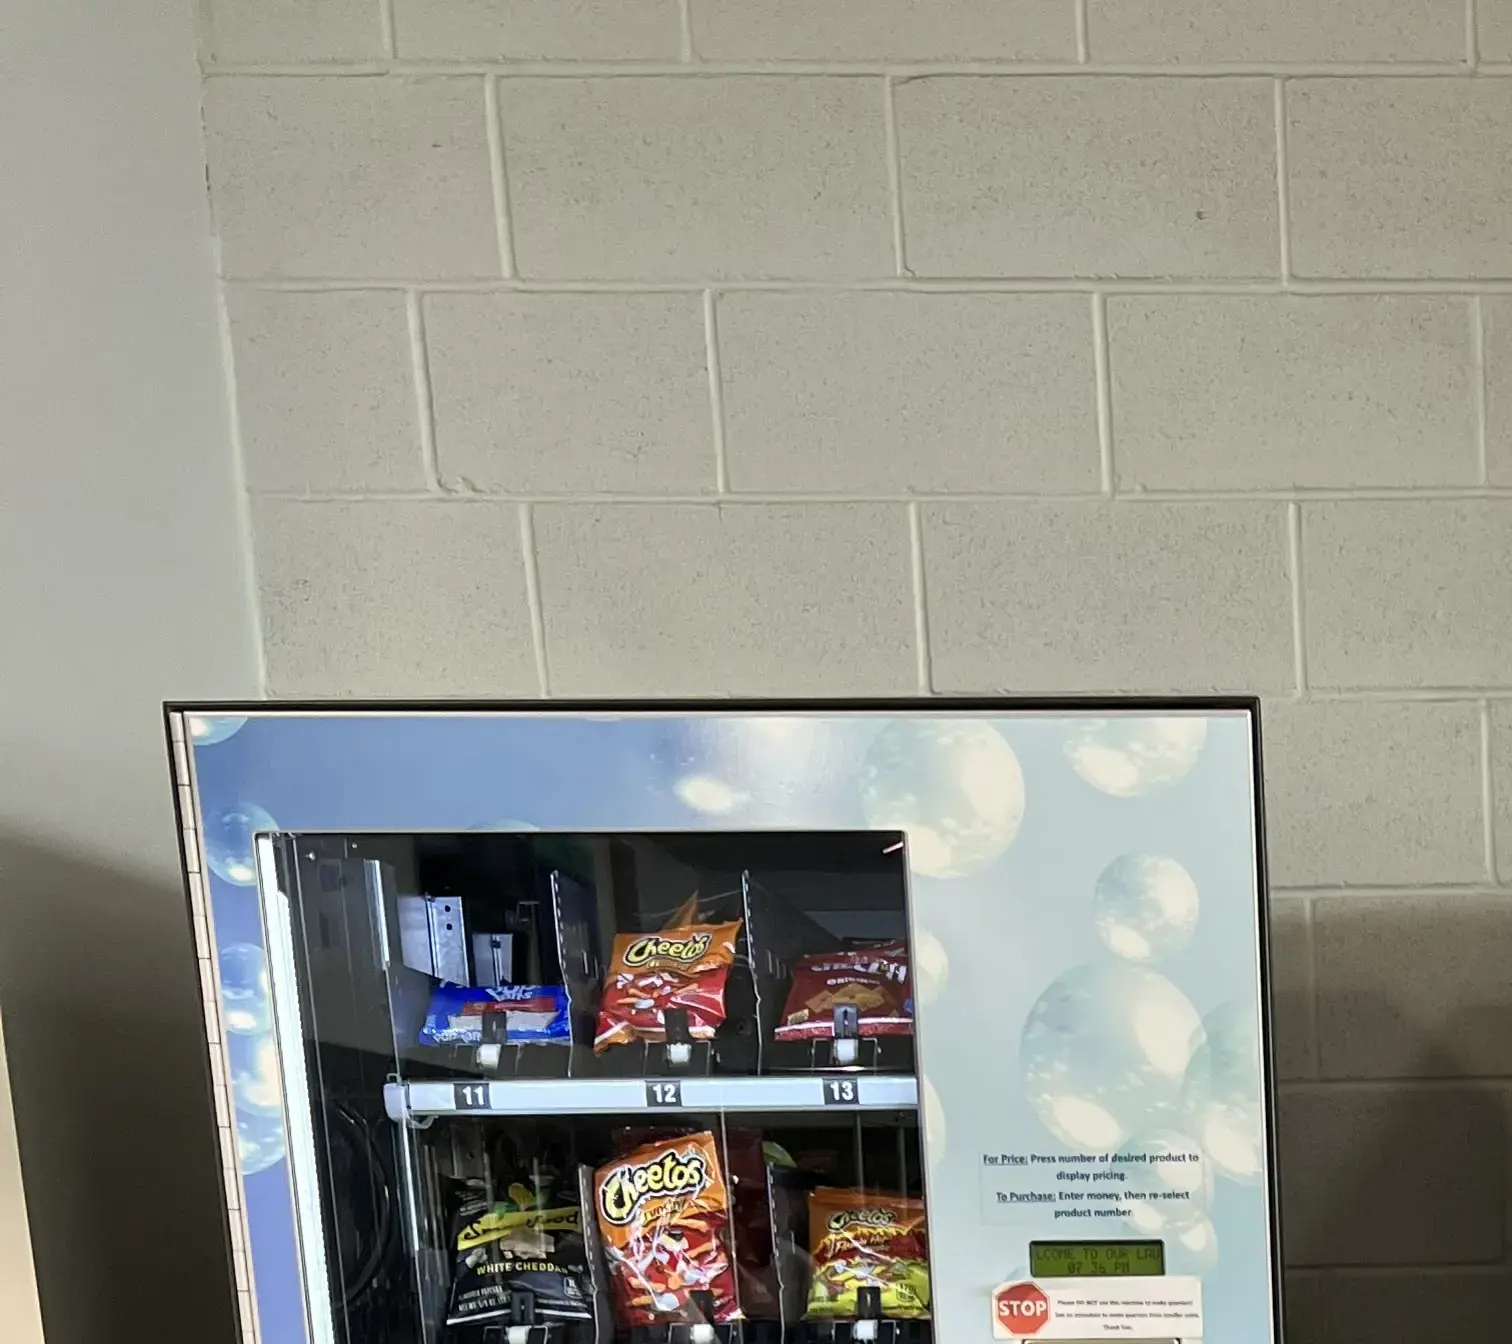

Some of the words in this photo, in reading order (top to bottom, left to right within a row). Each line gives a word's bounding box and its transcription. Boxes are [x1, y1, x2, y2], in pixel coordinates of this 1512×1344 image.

[624, 932, 711, 966] Cheetos
[463, 1086, 484, 1105] 11
[653, 1083, 676, 1103] 12
[830, 1080, 853, 1100] 13
[983, 1154, 999, 1164] For
[1001, 1154, 1028, 1164] Price:
[1031, 1154, 1056, 1163] Press
[1058, 1154, 1096, 1163] number
[1099, 1154, 1109, 1163] of
[1111, 1153, 1146, 1163] desired
[1149, 1154, 1186, 1165] product
[1189, 1154, 1199, 1162] to
[1056, 1171, 1090, 1182] display
[1093, 1171, 1128, 1182] pricing.
[603, 1150, 704, 1221] Cheetos
[996, 1192, 1008, 1202] To
[1010, 1192, 1056, 1202] Purchase:
[1058, 1191, 1084, 1201] Enter
[1087, 1192, 1121, 1202] money,
[1124, 1191, 1147, 1200] then
[1149, 1191, 1190, 1200] re-select
[828, 1208, 896, 1231] Cheetos
[1054, 1208, 1091, 1219] product
[1094, 1208, 1132, 1218] number.
[477, 1262, 512, 1275] WHITE
[1114, 1262, 1130, 1273] PM
[999, 1301, 1047, 1317] STOP
